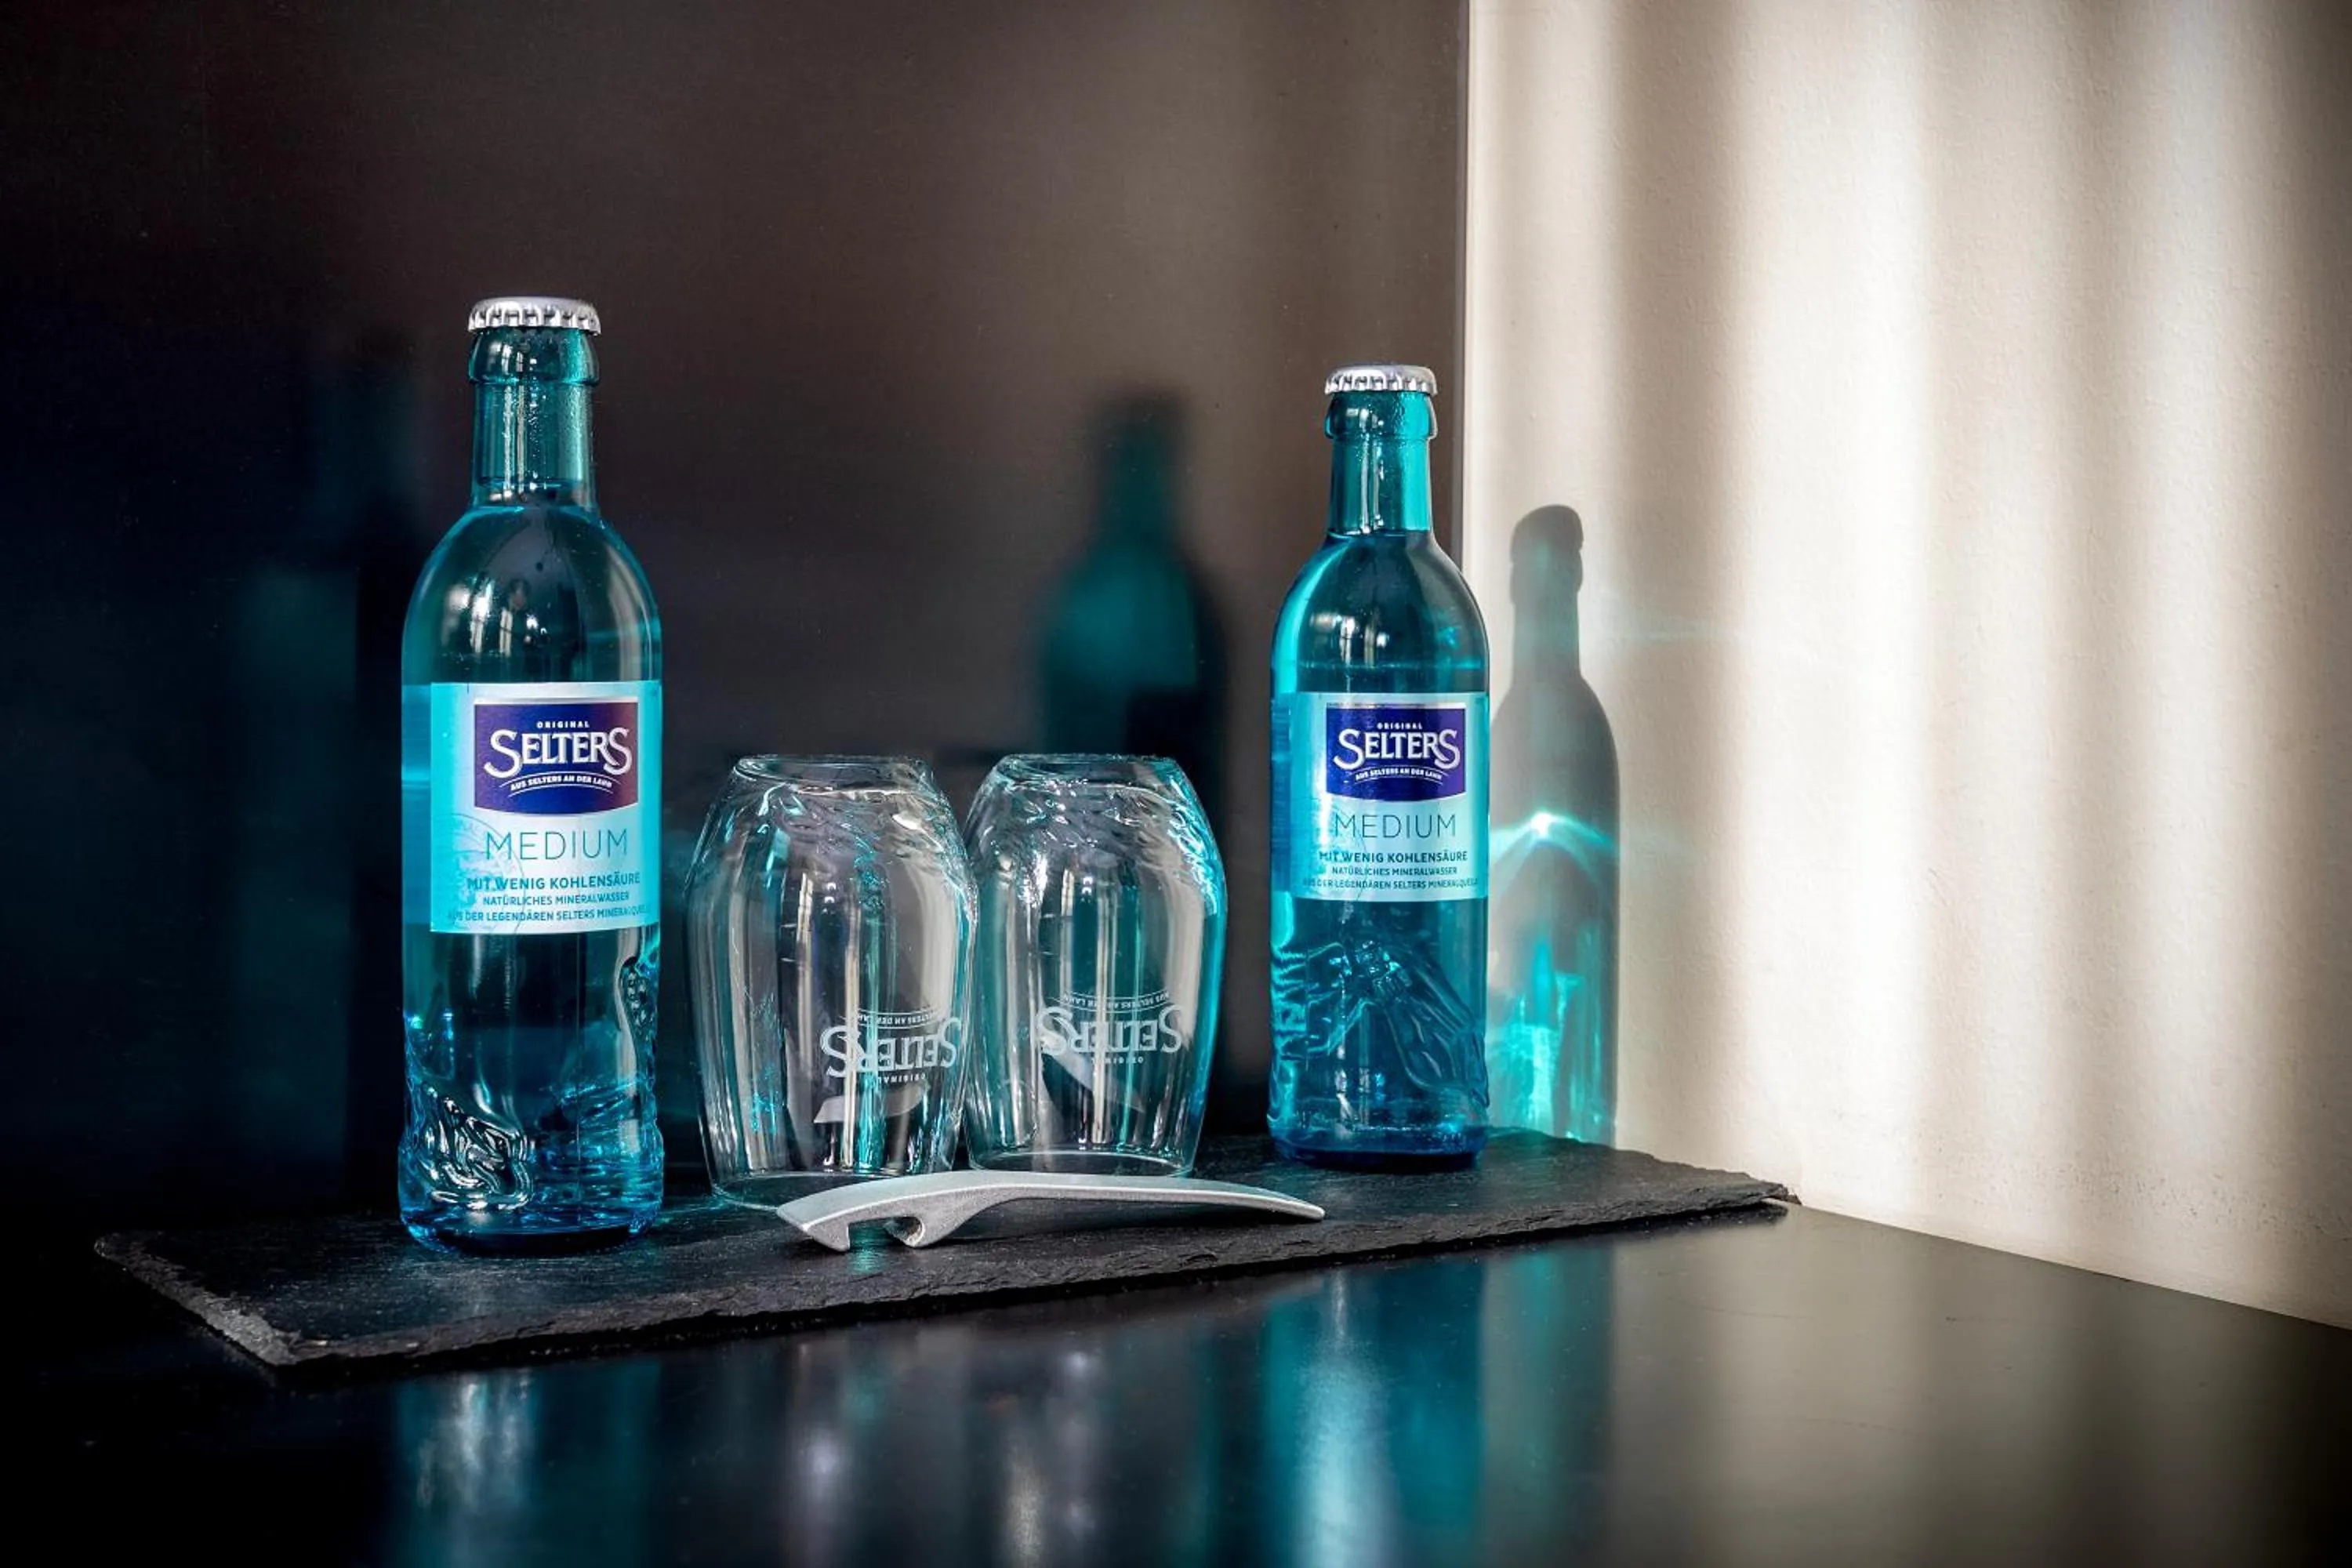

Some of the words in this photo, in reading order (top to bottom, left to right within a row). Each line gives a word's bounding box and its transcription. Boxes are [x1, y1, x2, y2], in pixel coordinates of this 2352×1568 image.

[536, 720, 590, 729] ORIGINAL
[1376, 721, 1424, 730] ORIGINAL
[483, 727, 633, 779] SELTERS
[1333, 728, 1461, 770] SELTERS
[1355, 771, 1370, 781] AUS
[1370, 767, 1399, 777] SELTERS
[1410, 767, 1425, 775] DER
[1425, 769, 1443, 780] LAHN
[510, 781, 528, 791] AUS
[528, 775, 562, 786] SELTERS
[576, 775, 592, 783] DER
[1334, 814, 1457, 839] MEDIUM
[485, 829, 627, 861] MEDIUM
[1319, 851, 1340, 862] MIT
[1341, 852, 1385, 863] WENIG
[1387, 848, 1468, 863] KOHLENSÄURE
[1331, 865, 1391, 877] NATÜRLICHES
[1392, 866, 1457, 877] MINERALWASSER
[466, 876, 491, 891] MIT
[493, 877, 546, 891] WENIG
[550, 870, 641, 890] KOHLENSÄURE
[1316, 878, 1334, 888] DER
[1334, 879, 1392, 890] LEGENDÄREN
[1393, 880, 1427, 890] SELTERS
[482, 894, 553, 906] NATÜRLICHES
[555, 890, 630, 905] MINERALWASSER
[465, 911, 484, 921] DER
[486, 909, 554, 921] LEGENDÄREN
[556, 909, 595, 920] SELTERS
[1036, 1004, 1185, 1055] SELTERS
[819, 1017, 962, 1078] SELTERS
[1091, 1055, 1144, 1065] ORGINL
